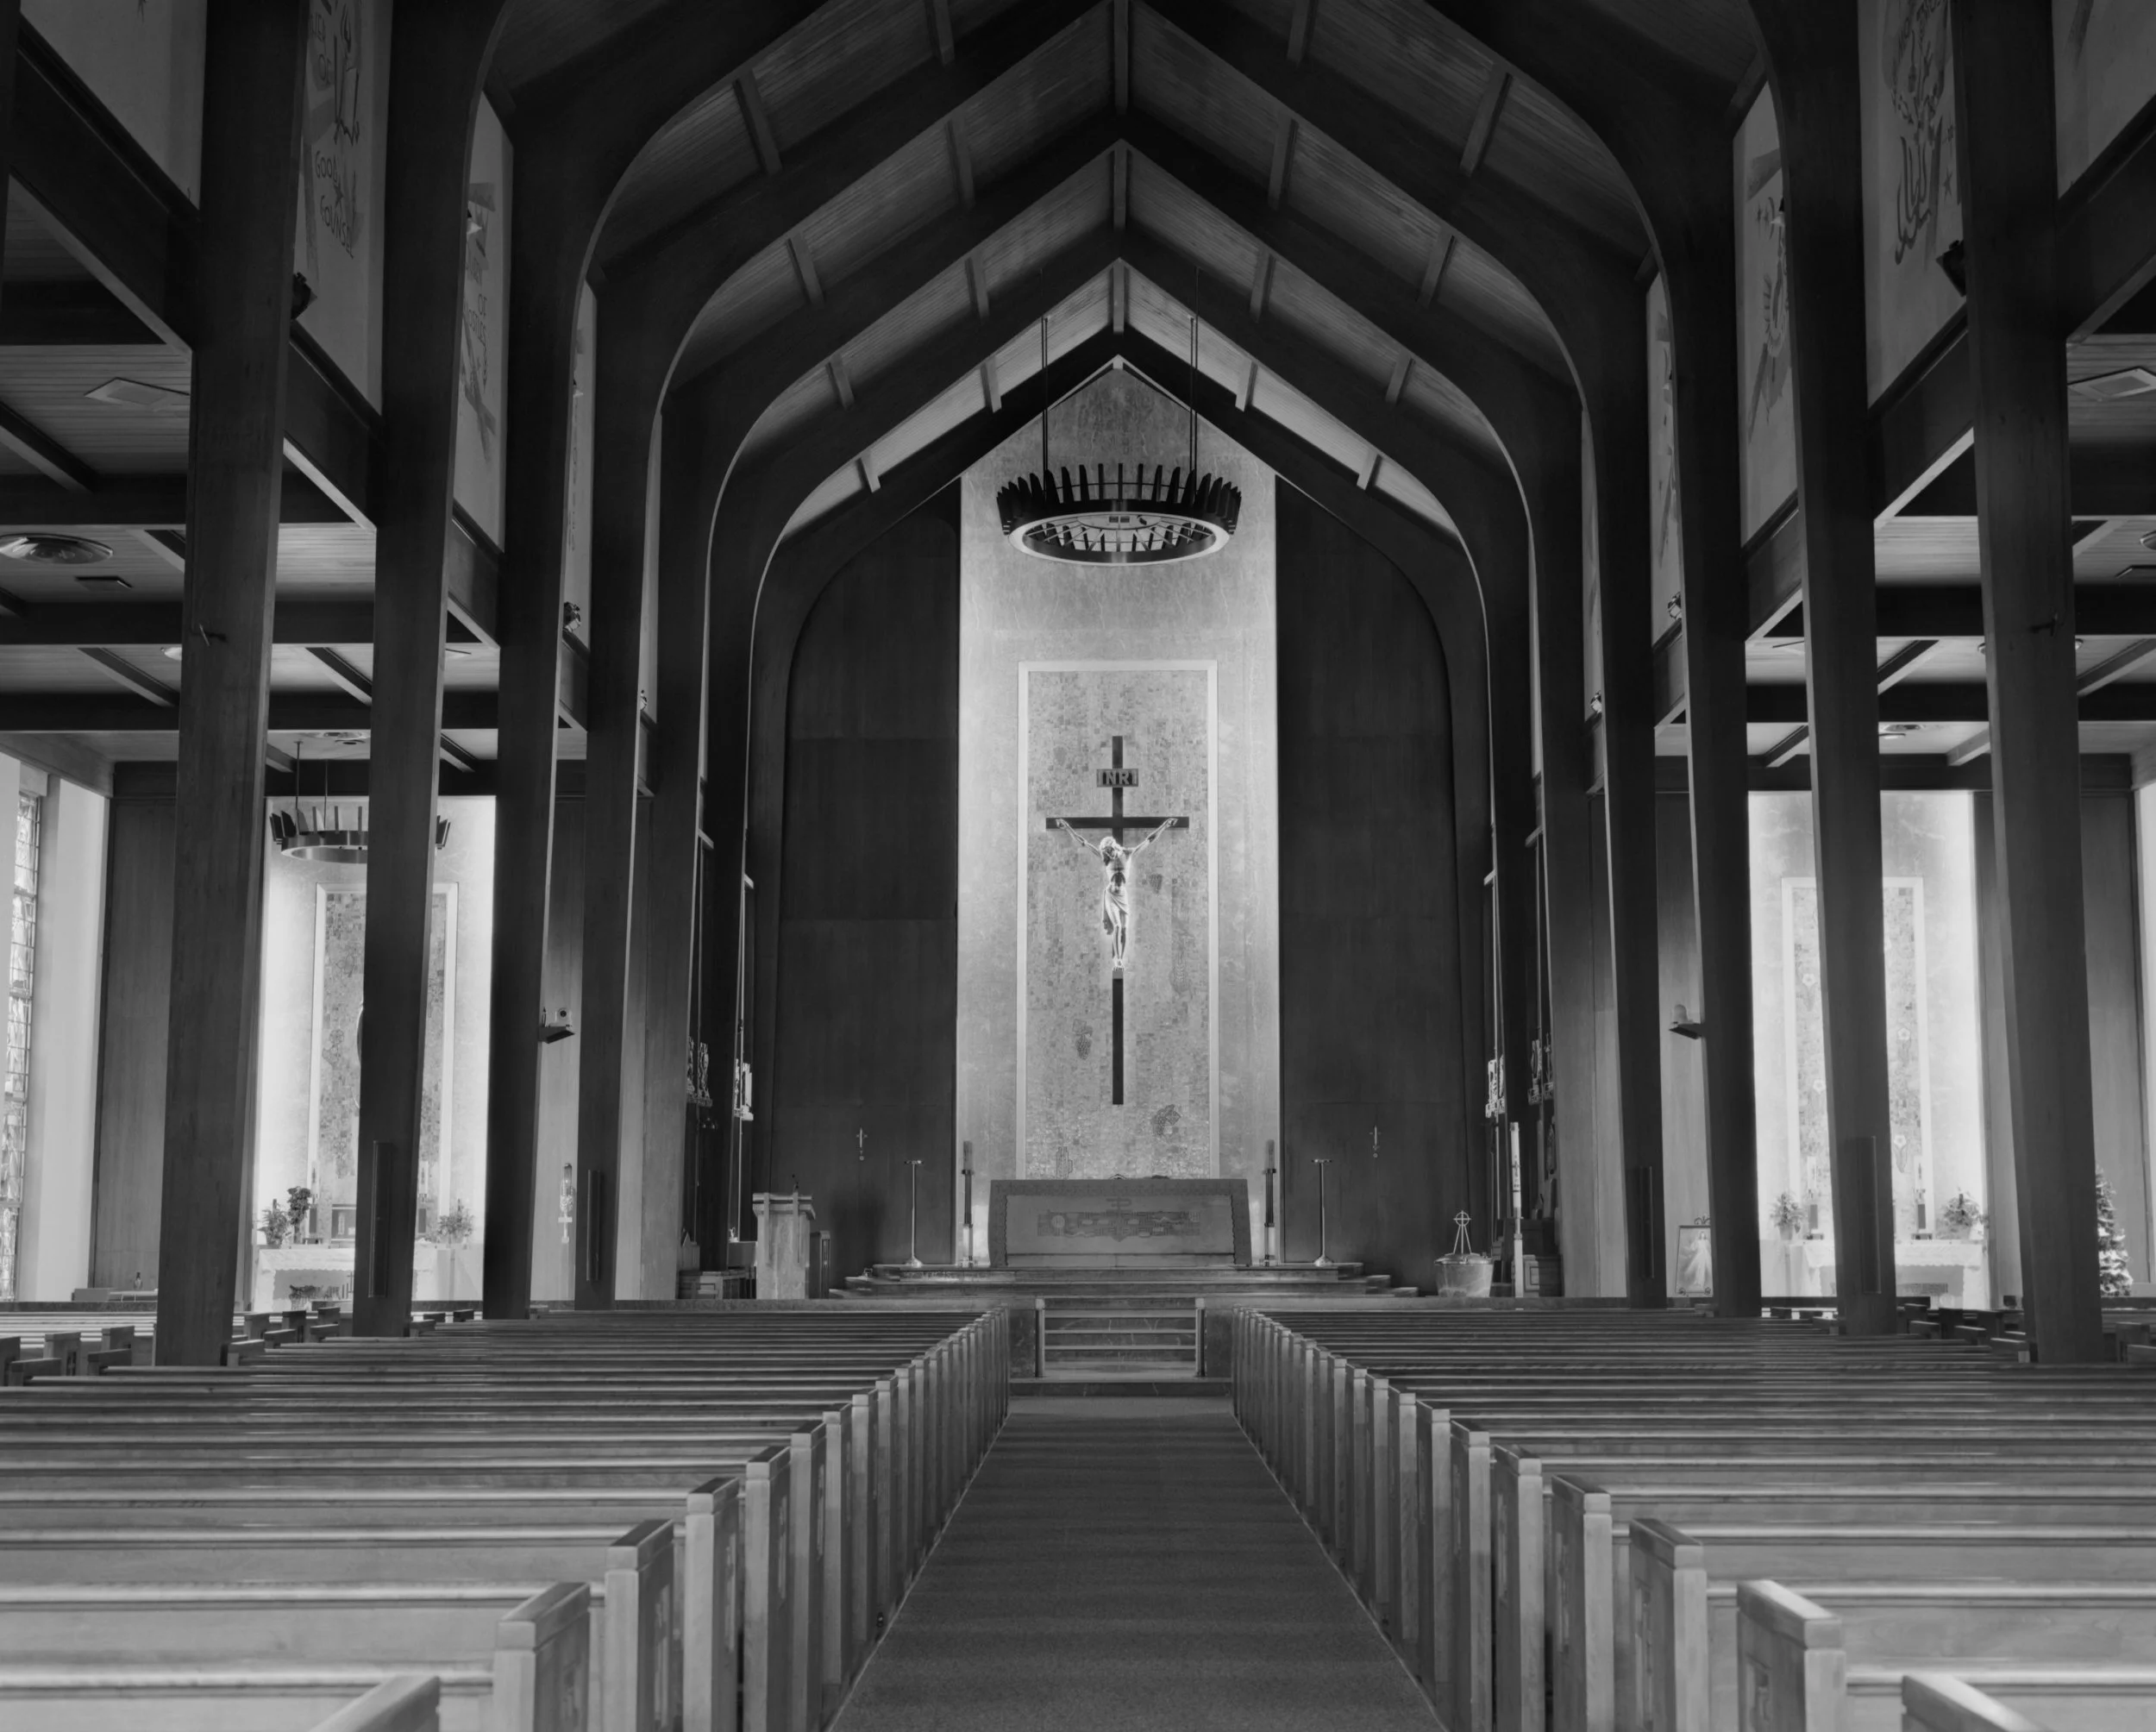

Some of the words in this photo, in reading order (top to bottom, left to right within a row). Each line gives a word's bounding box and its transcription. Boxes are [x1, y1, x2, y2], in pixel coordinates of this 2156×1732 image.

[315, 150, 338, 183] GOOD
[320, 195, 354, 259] COUNSEL
[1098, 769, 1138, 785] INRI
